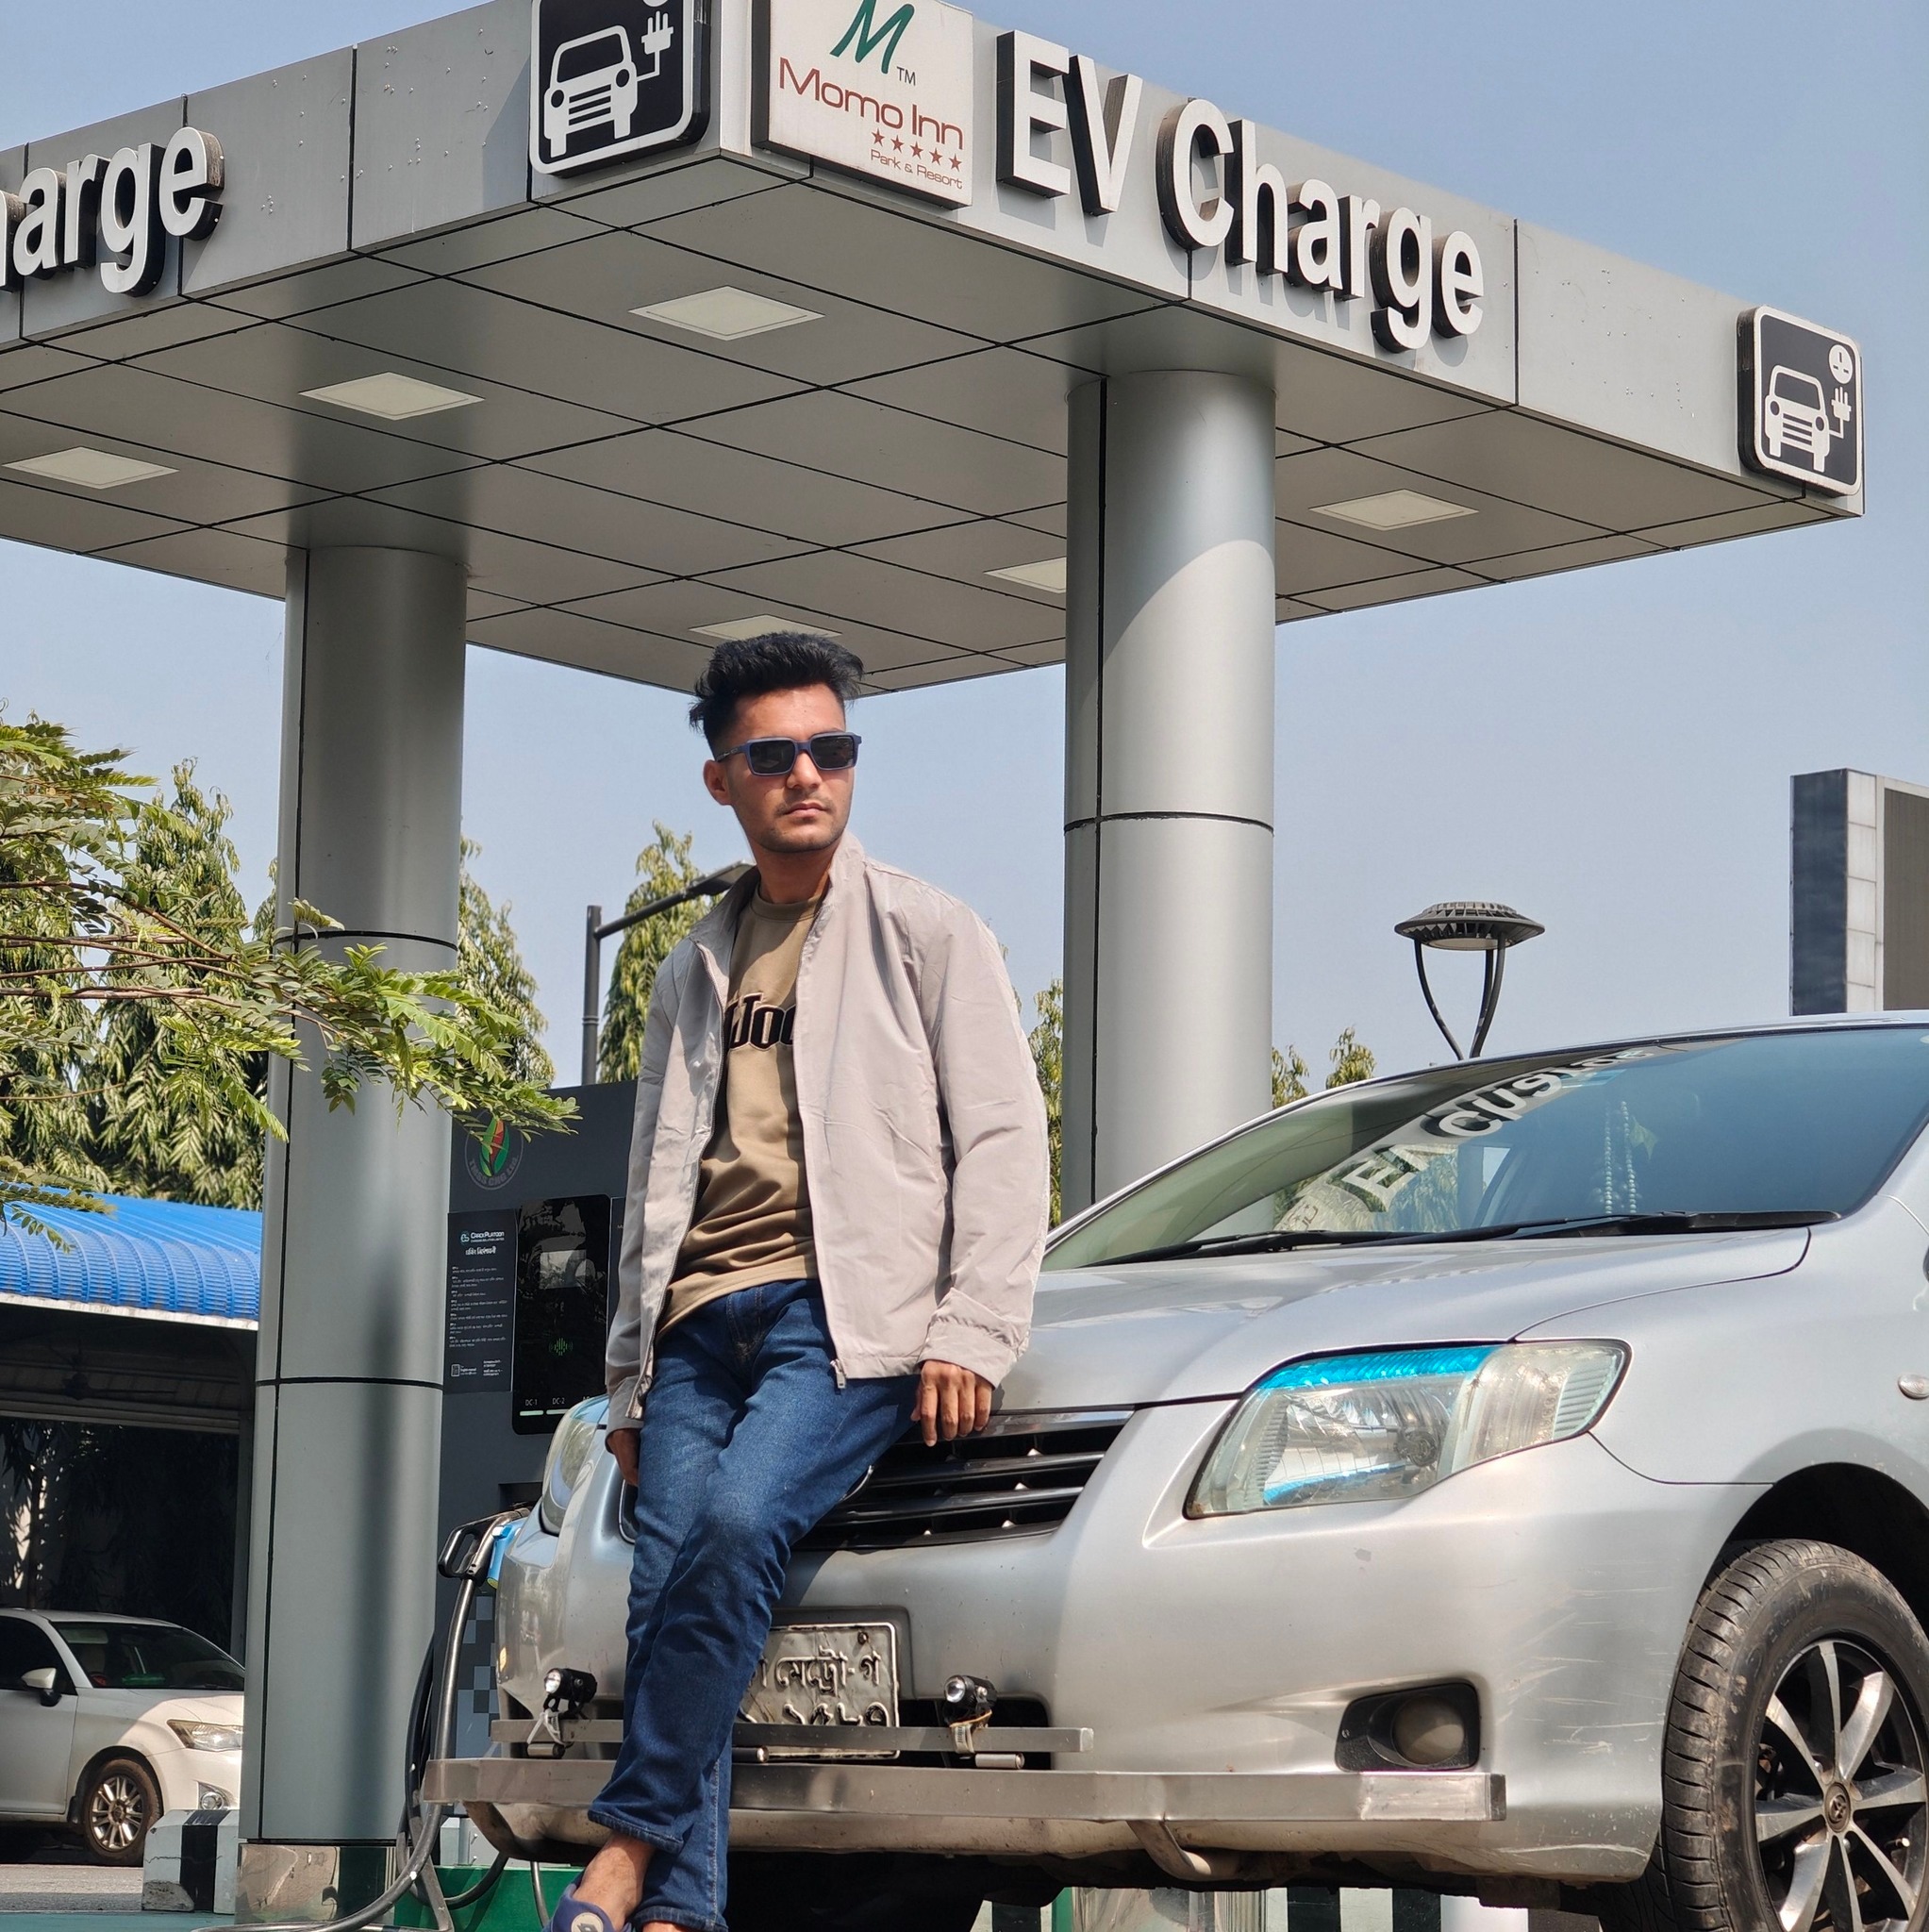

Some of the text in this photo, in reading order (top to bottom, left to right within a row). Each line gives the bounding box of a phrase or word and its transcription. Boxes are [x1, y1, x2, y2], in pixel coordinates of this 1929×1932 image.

[829, 0, 915, 74] M
[779, 57, 963, 150] Momo Inn
[897, 66, 916, 86] TM
[871, 149, 963, 189] Park & Resort
[997, 30, 1484, 353] EV Charge
